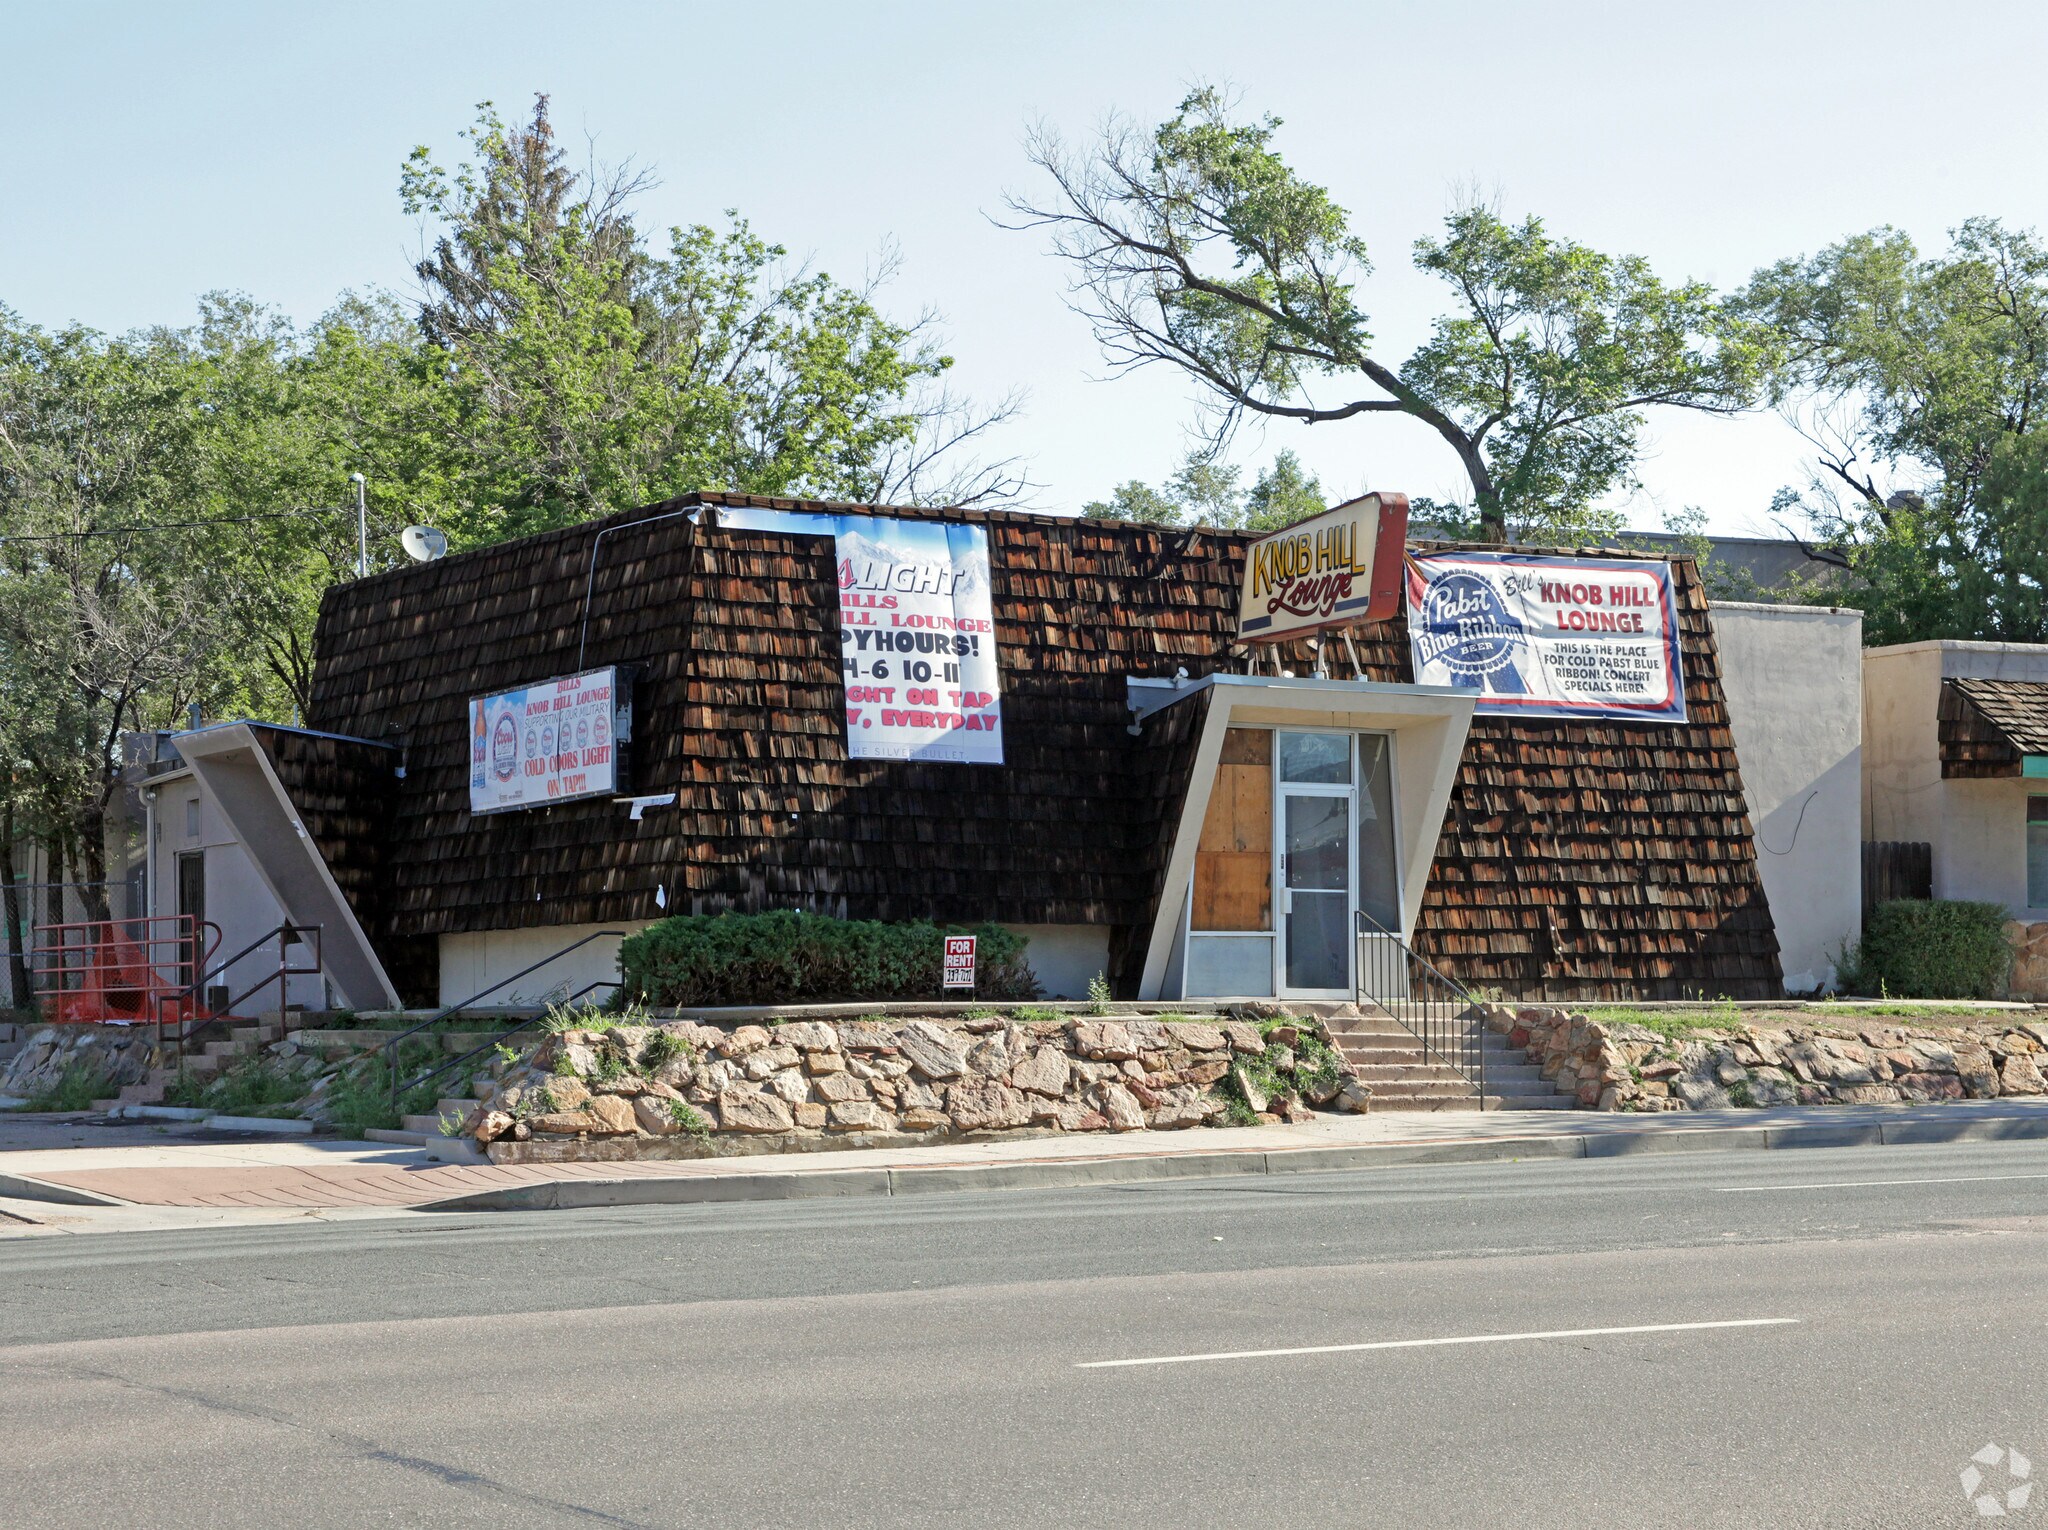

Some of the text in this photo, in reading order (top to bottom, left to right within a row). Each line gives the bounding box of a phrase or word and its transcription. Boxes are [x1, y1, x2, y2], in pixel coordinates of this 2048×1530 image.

[1253, 521, 1366, 599] KNOB HILL
[856, 562, 966, 596] LIGHT
[839, 593, 899, 610] ILLS
[1267, 571, 1353, 618] Lounge
[1430, 585, 1491, 623] Pabst
[1541, 582, 1654, 607] KNOB HILL
[891, 613, 992, 634] LOUNGE
[1557, 610, 1644, 633] LOUNGE
[1418, 614, 1523, 663] Blue Ribbon
[1461, 642, 1494, 655] BEER
[1554, 643, 1647, 657] THIS IS THE PLACE
[903, 660, 960, 683] 10-11
[1544, 654, 1660, 669] FOR COLD PABST BLUE
[557, 677, 582, 694] BILLS
[1555, 668, 1650, 682] RIBBON! CONCERT
[845, 686, 994, 708] GHT ON TAP
[1565, 681, 1645, 693] SPECIALS HERE!
[526, 686, 610, 716] KNOB HILL LOUNGE
[524, 702, 609, 729] SUPPORTING OUR MILITARY
[881, 708, 999, 731] EVERYDAY
[524, 757, 546, 778] COLD
[549, 750, 579, 773] COORS
[582, 745, 611, 767] LIGHT
[874, 747, 915, 758] SILVER
[547, 773, 587, 797] ON TAP!!!
[950, 941, 970, 954] FOR
[947, 954, 973, 967] RENT
